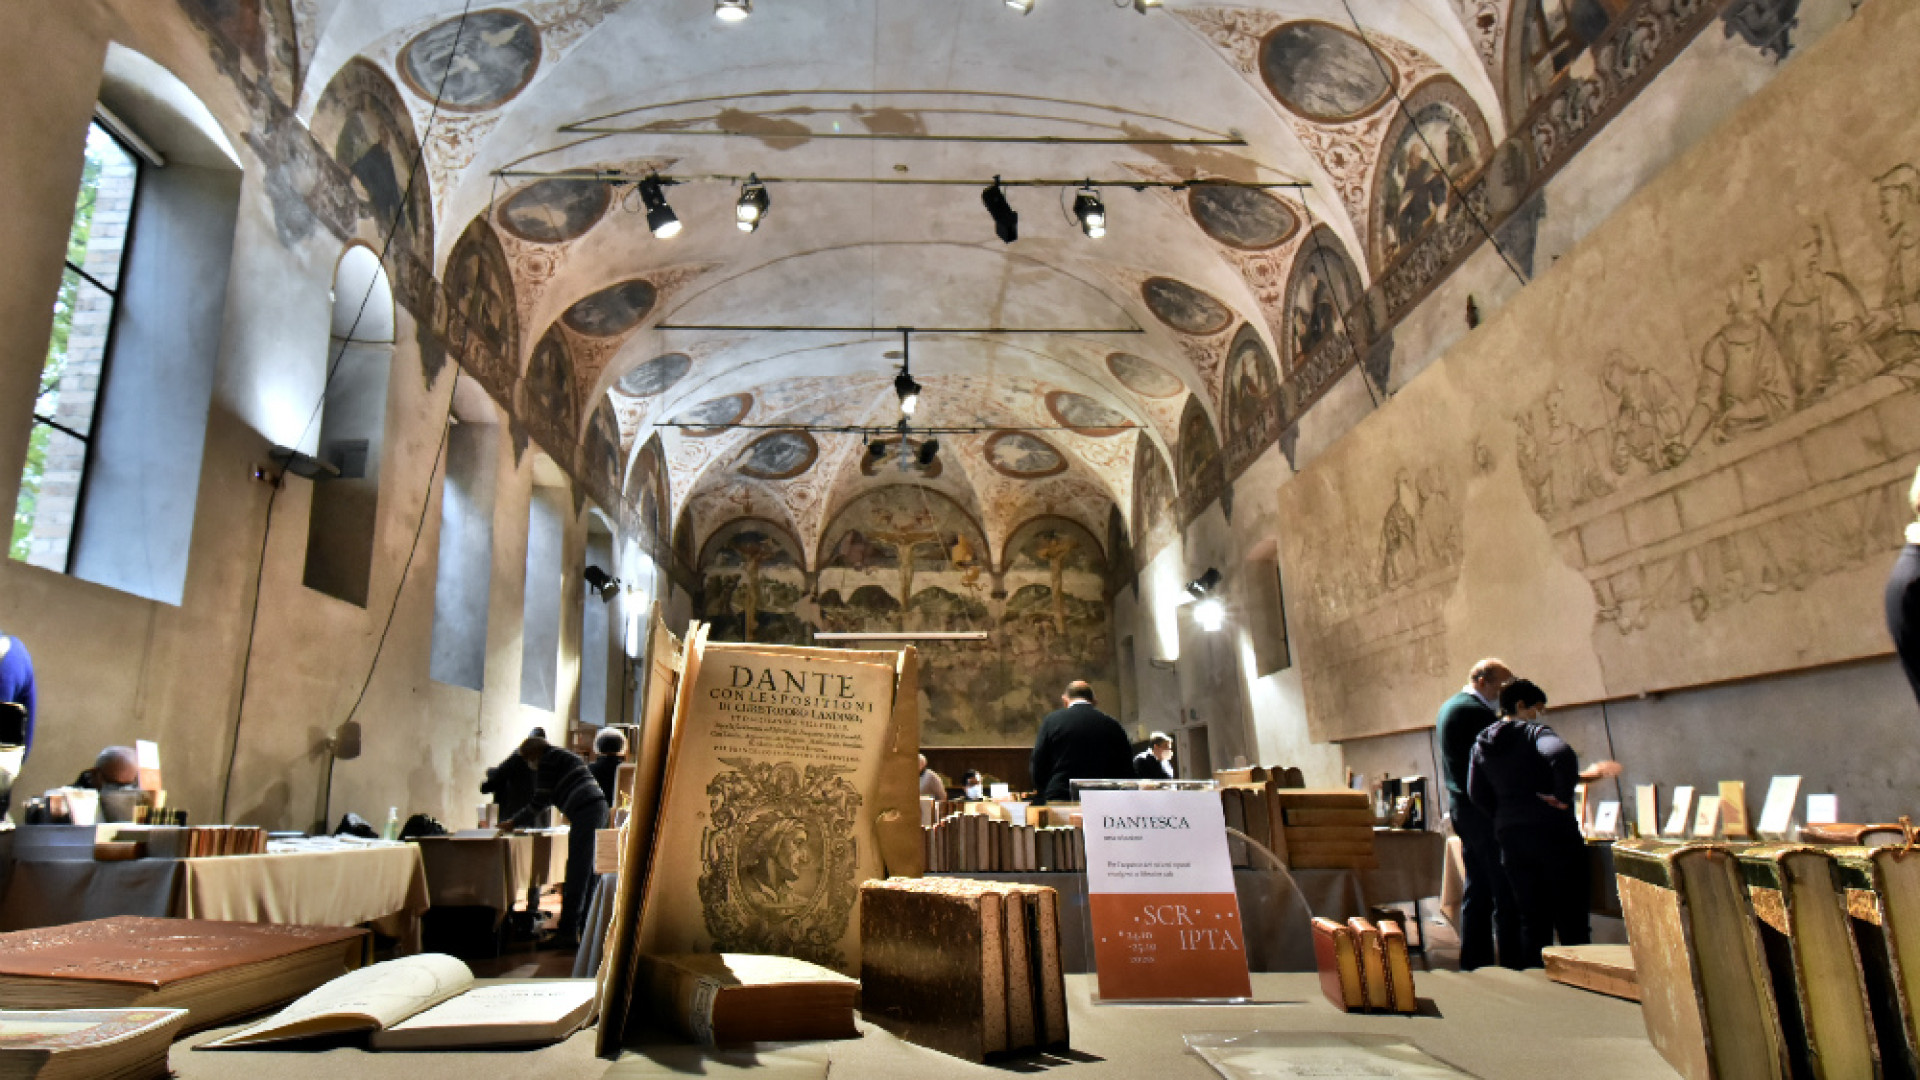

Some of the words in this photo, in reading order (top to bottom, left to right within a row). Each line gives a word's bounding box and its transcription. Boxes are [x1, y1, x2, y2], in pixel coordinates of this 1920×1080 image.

[730, 665, 855, 699] DANTE
[710, 688, 744, 700] CON
[1103, 816, 1190, 829] DANTESCA
[1144, 905, 1194, 925] SCR
[1179, 929, 1239, 950] IPTA
